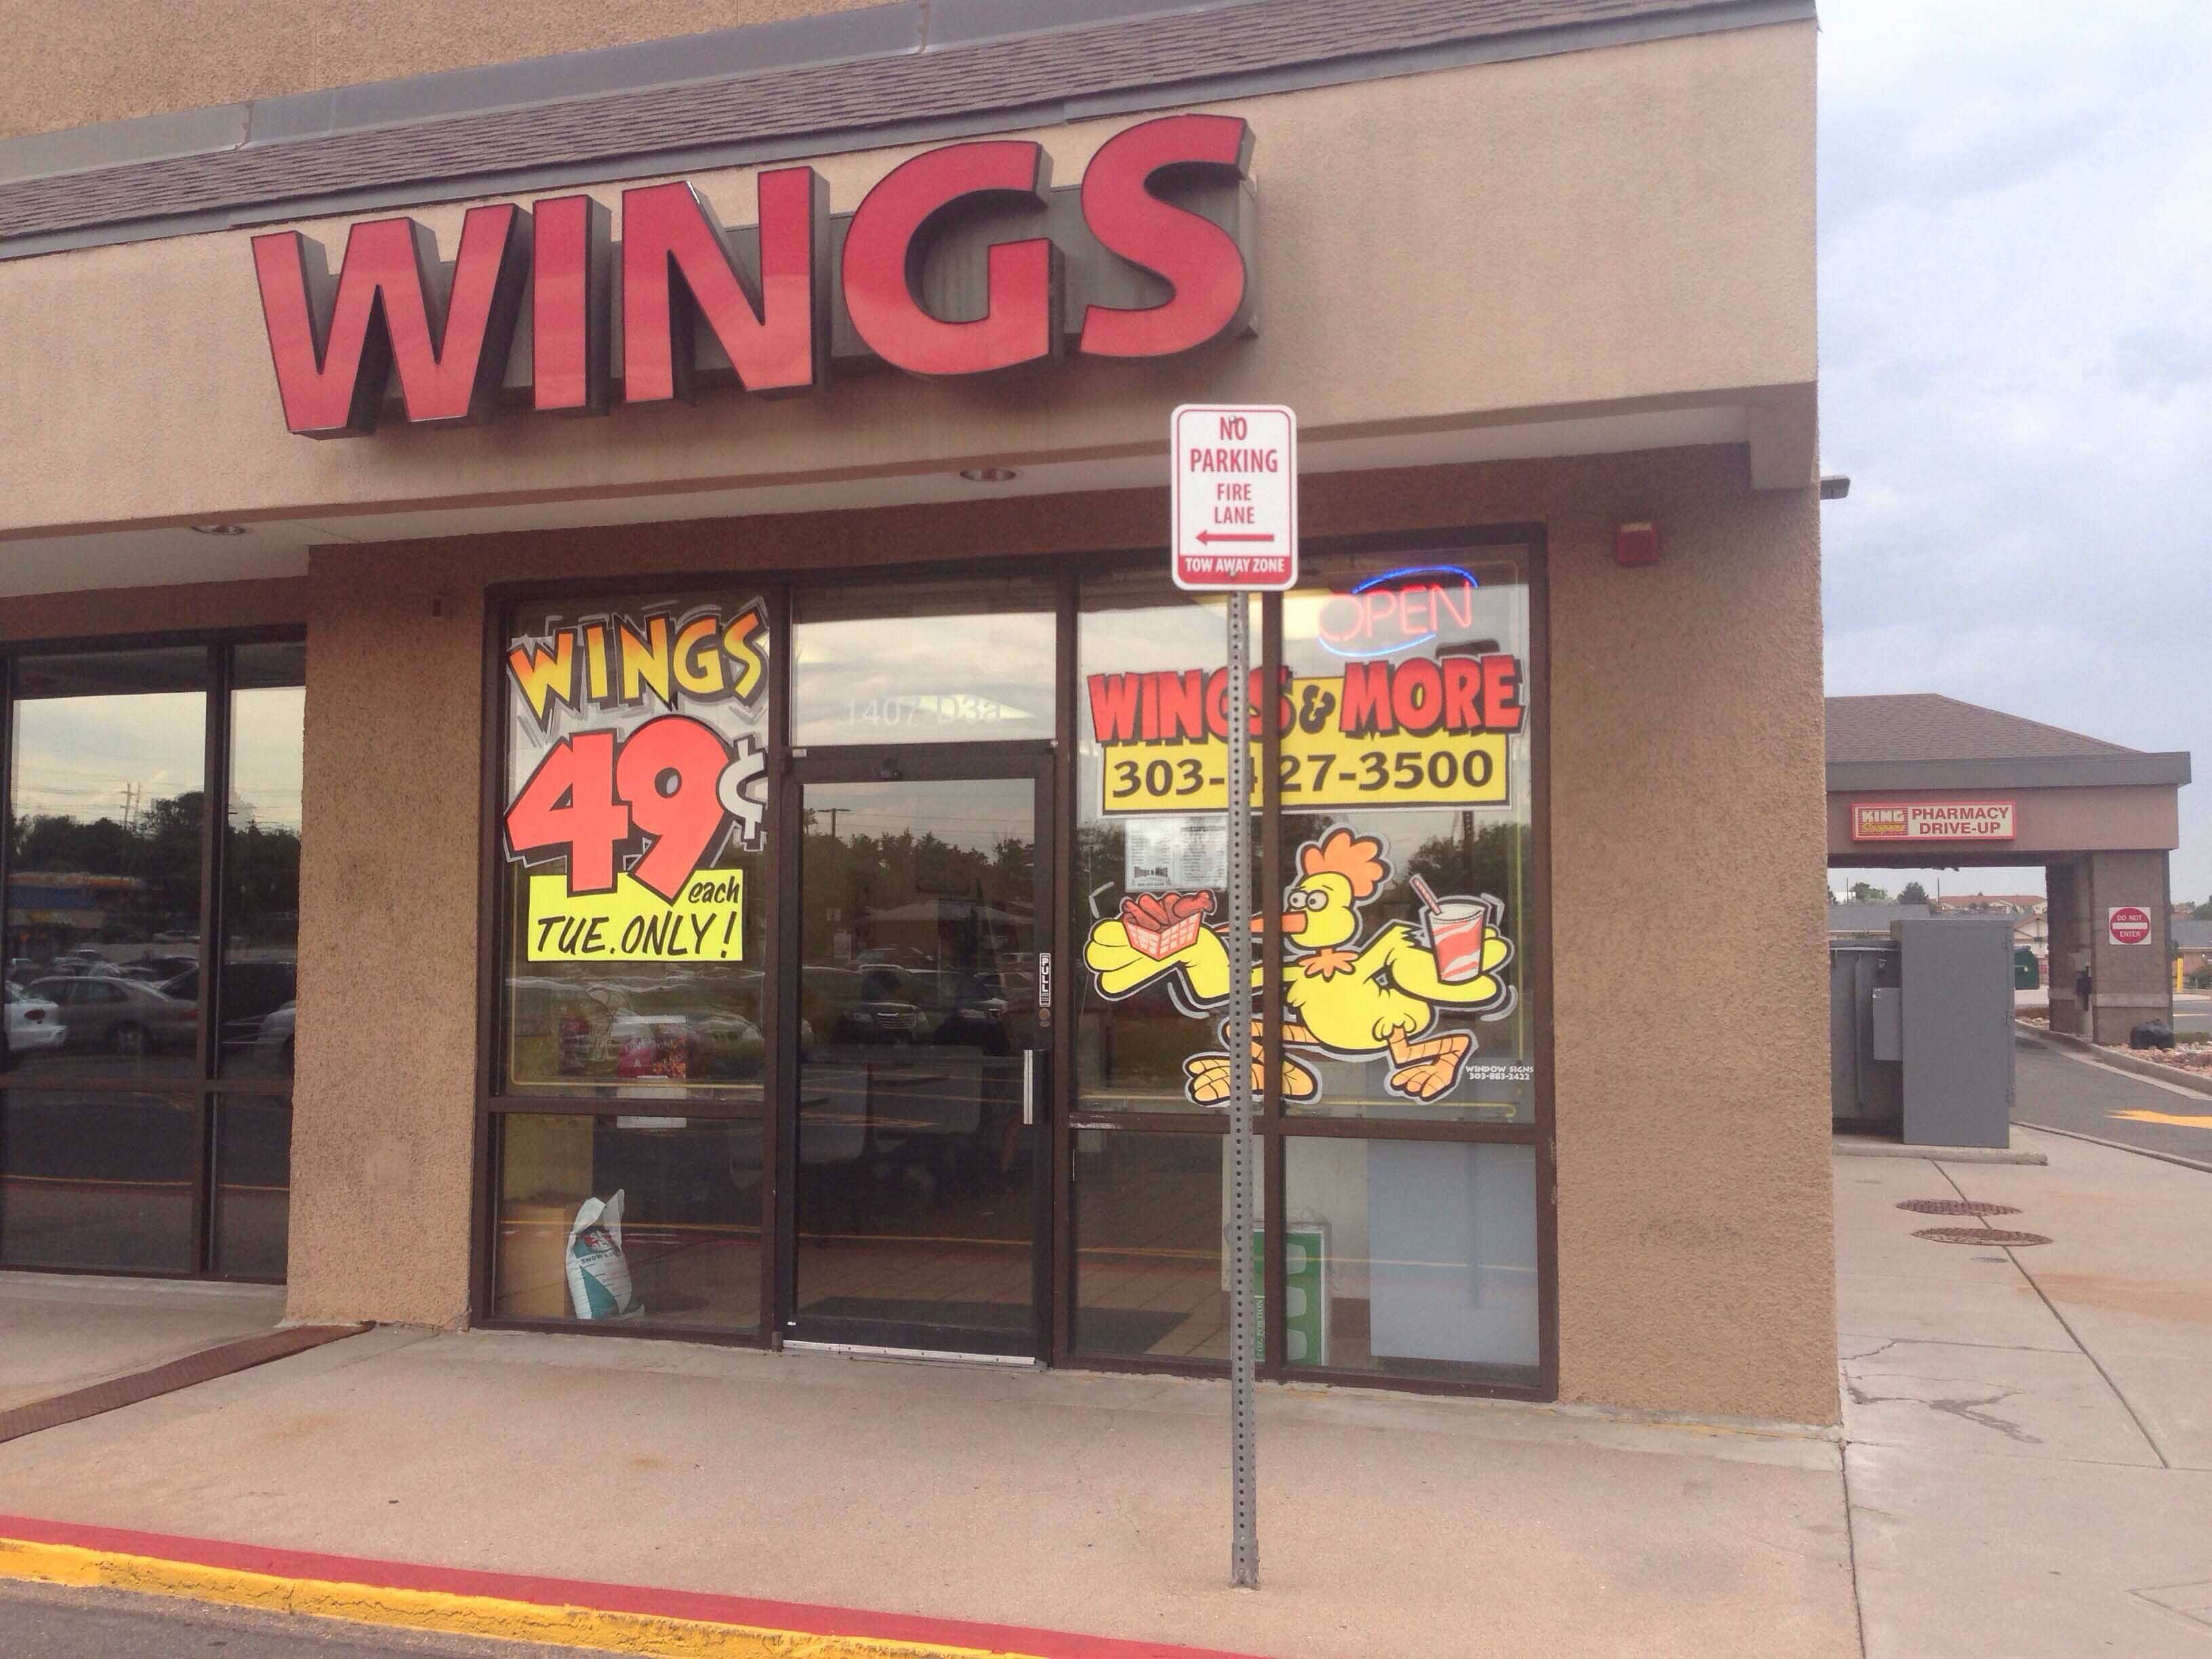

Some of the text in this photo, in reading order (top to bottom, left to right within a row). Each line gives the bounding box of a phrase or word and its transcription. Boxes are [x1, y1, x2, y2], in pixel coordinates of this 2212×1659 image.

[251, 113, 1250, 434] WINGS
[1220, 415, 1247, 441] NO
[1190, 449, 1278, 472] PARKING
[1217, 483, 1252, 501] FIRE
[1214, 506, 1255, 524] LANE
[1185, 557, 1285, 573] TOW AWAY ZONE
[1319, 580, 1472, 641] OPEN
[510, 610, 764, 724] WINGS
[1300, 684, 1336, 734] &
[1339, 655, 1526, 737] MORE
[1912, 807, 2009, 820] PHARMACY
[1919, 821, 2001, 834] DRIVE-UP
[688, 876, 740, 903] each
